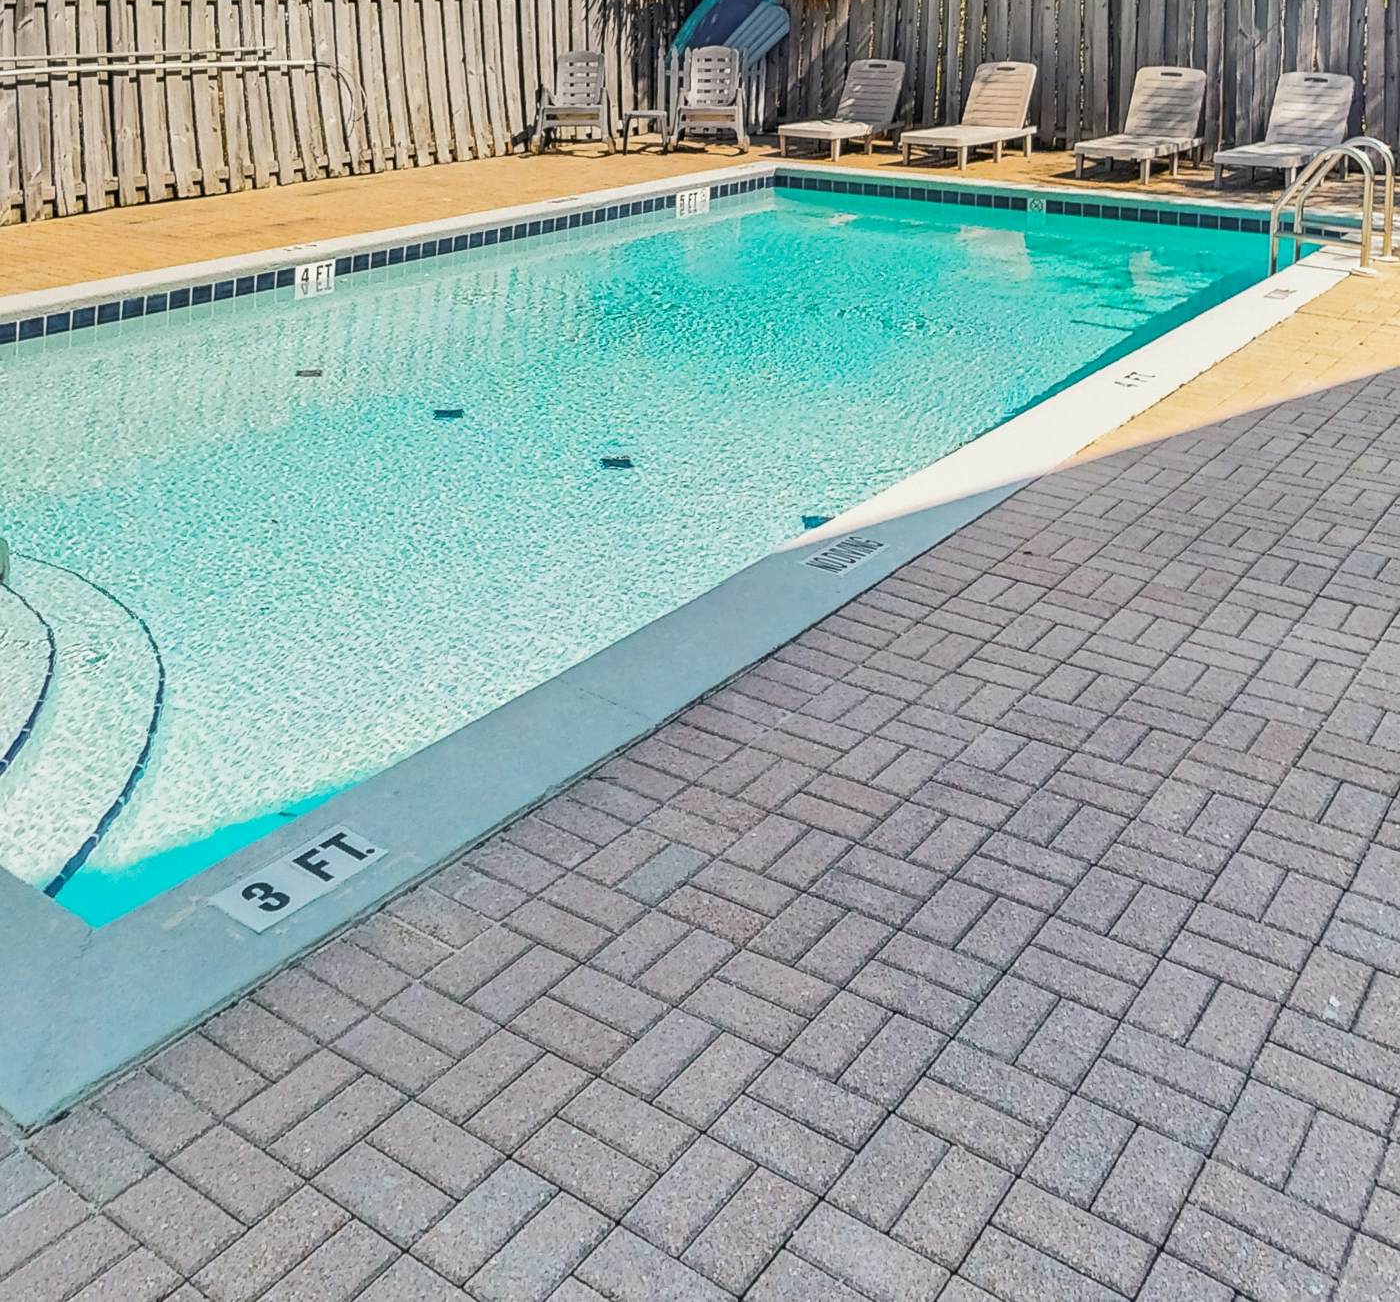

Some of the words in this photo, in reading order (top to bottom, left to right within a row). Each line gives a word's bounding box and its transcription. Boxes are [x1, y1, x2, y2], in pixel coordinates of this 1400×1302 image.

[301, 268, 309, 282] 4
[316, 263, 332, 281] FT
[820, 536, 884, 564] DIVING
[805, 557, 848, 574] NO
[241, 882, 290, 912] 3
[292, 831, 376, 882] FT.
